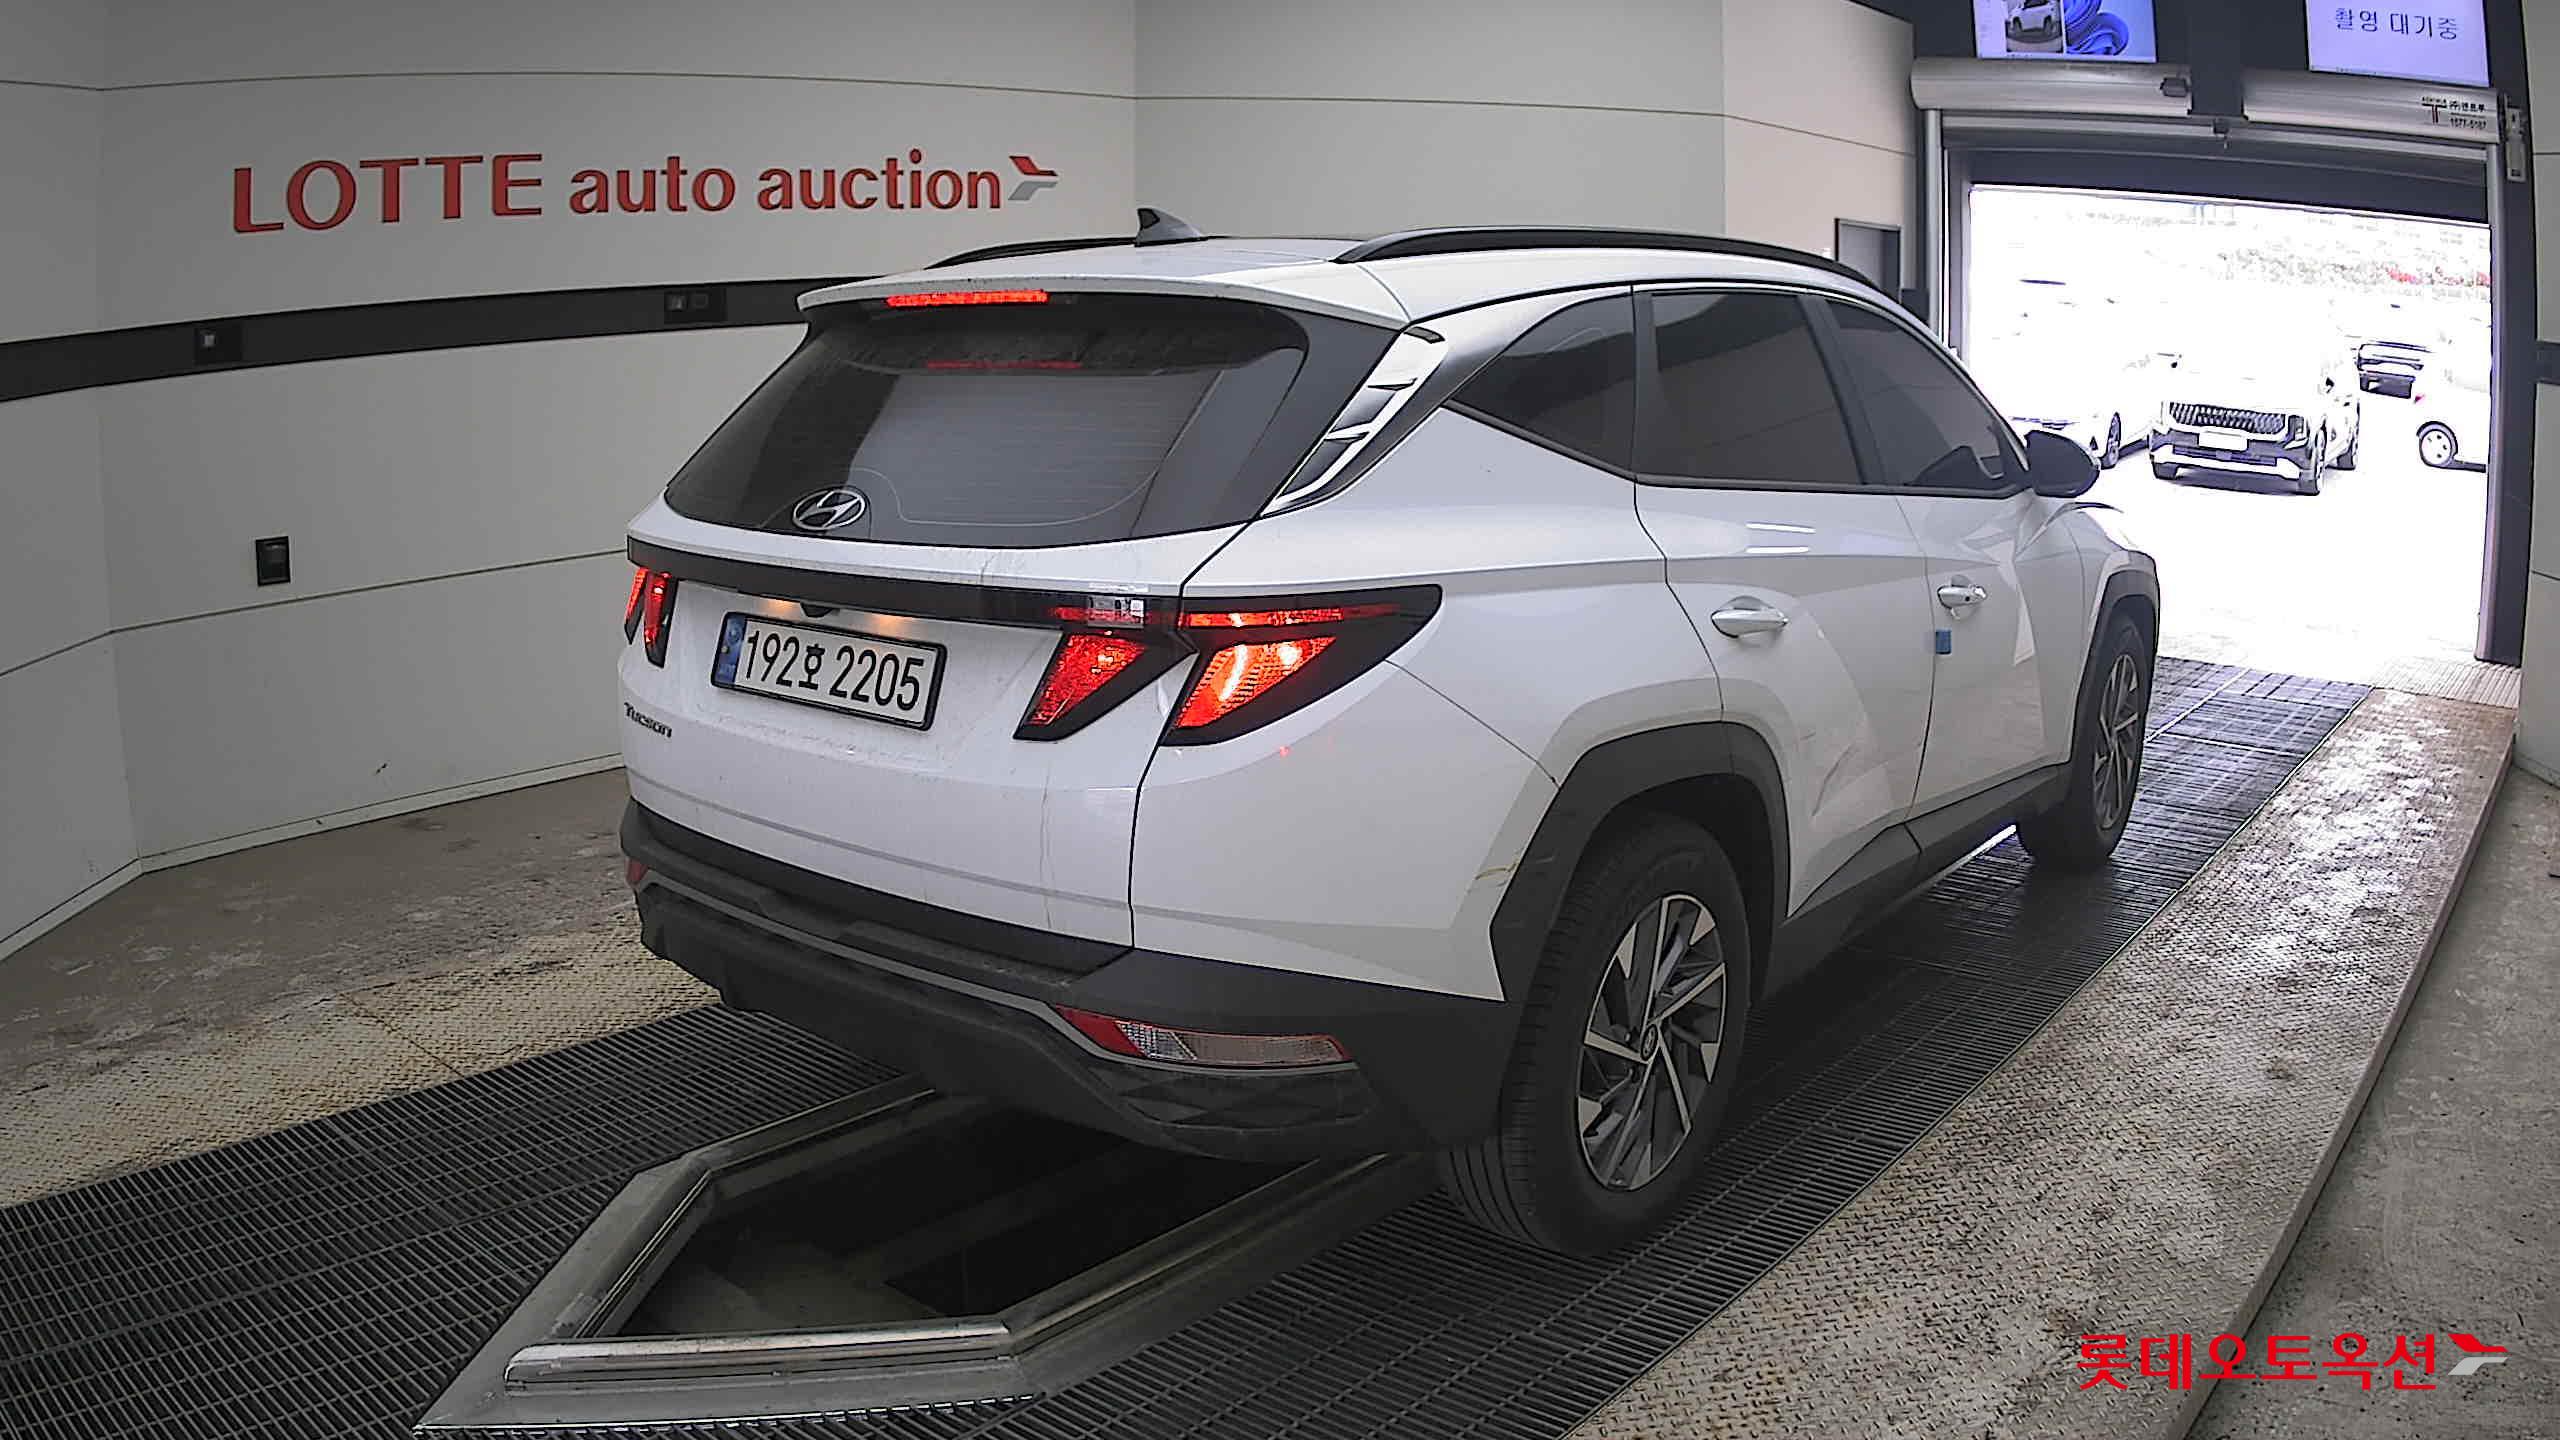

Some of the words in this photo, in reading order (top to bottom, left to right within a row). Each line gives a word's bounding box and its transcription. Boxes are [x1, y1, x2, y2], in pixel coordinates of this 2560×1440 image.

[2335, 7, 2379, 33] 촬영
[2390, 12, 2458, 41] 대기중
[234, 154, 543, 234] LOTTE
[568, 156, 736, 213] auto
[757, 148, 1001, 212] auction
[746, 629, 826, 691] 192호
[828, 644, 925, 712] 2205
